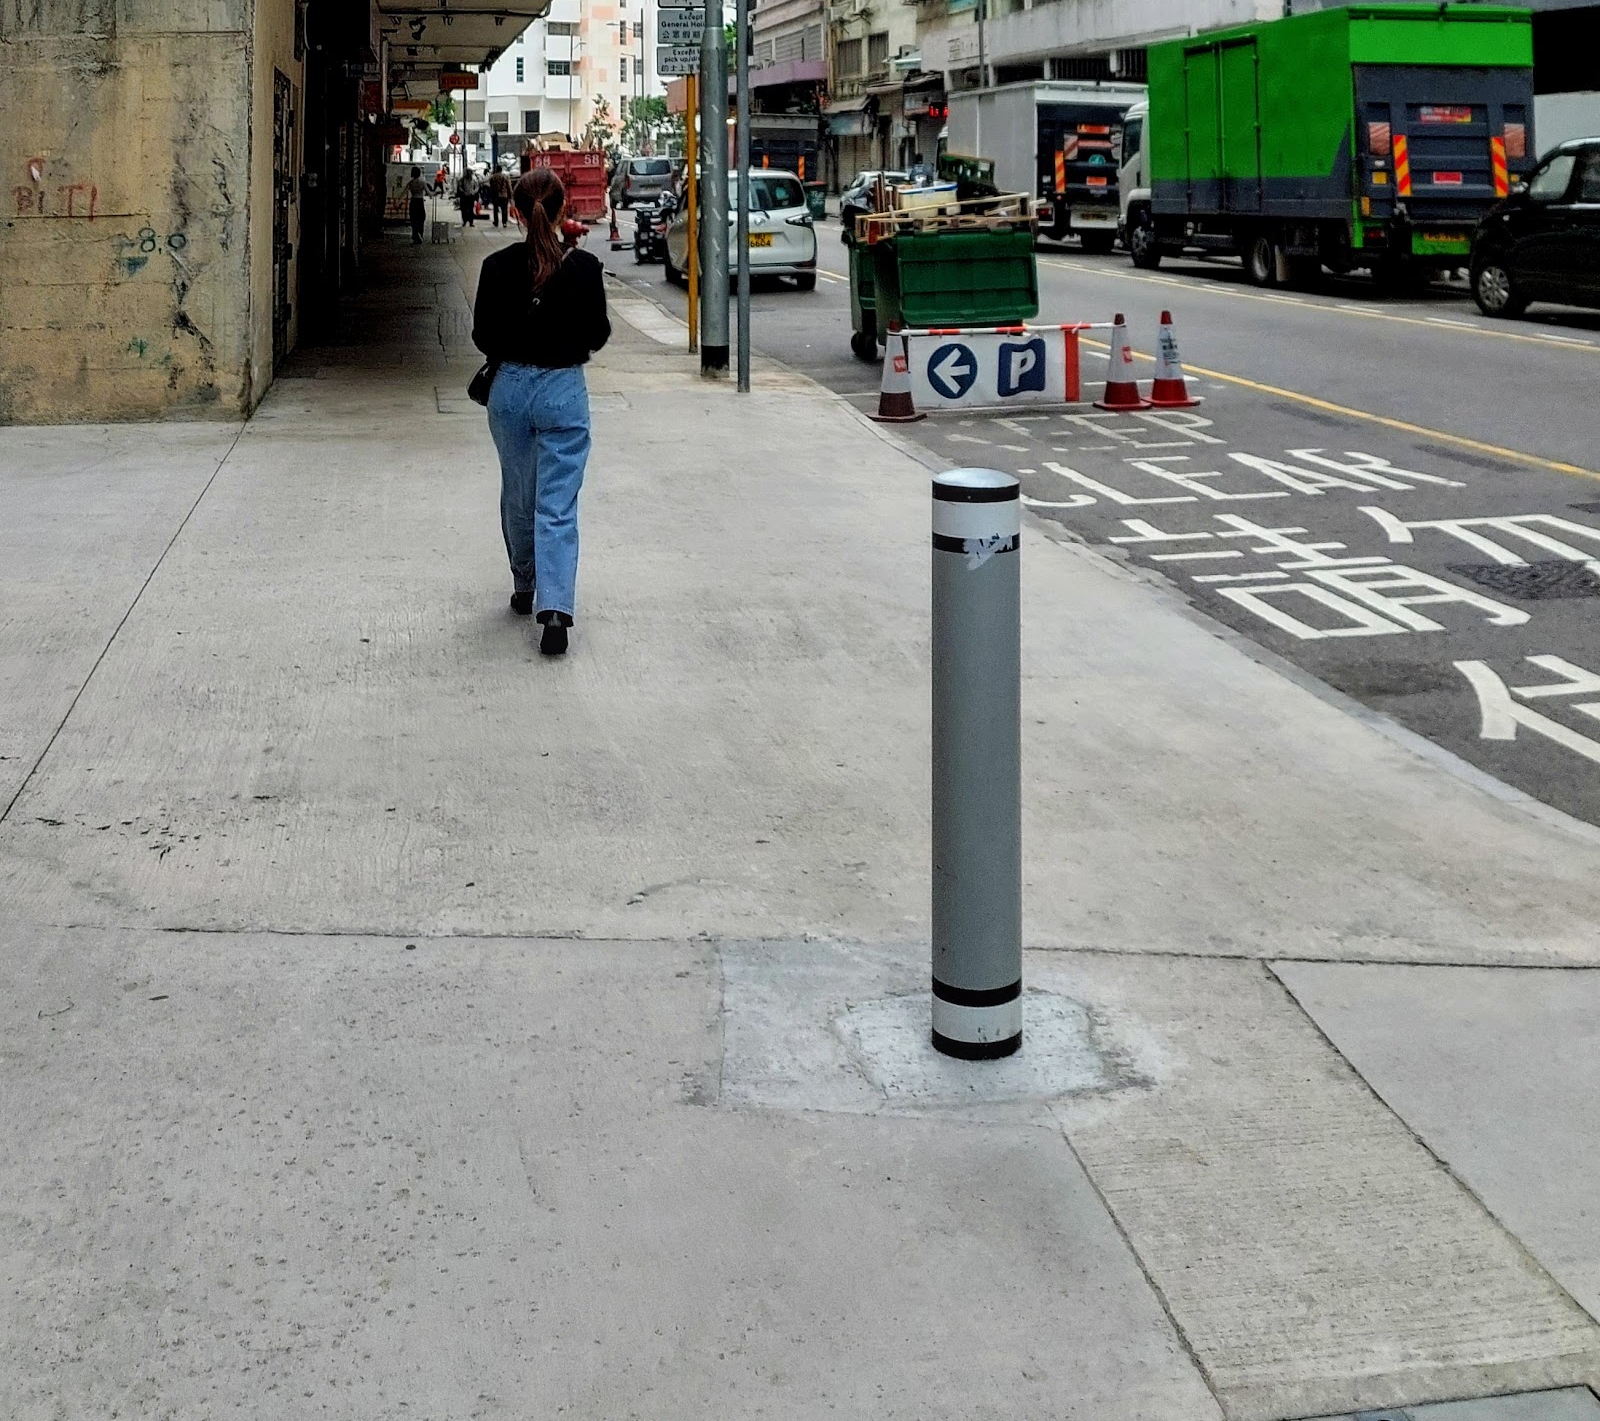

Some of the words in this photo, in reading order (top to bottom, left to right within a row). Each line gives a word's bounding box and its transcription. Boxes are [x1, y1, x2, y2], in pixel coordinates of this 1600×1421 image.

[678, 13, 703, 21] Except
[661, 20, 689, 28] General
[662, 30, 701, 39] 公眾假期
[584, 154, 600, 165] 58
[1010, 349, 1037, 389] P
